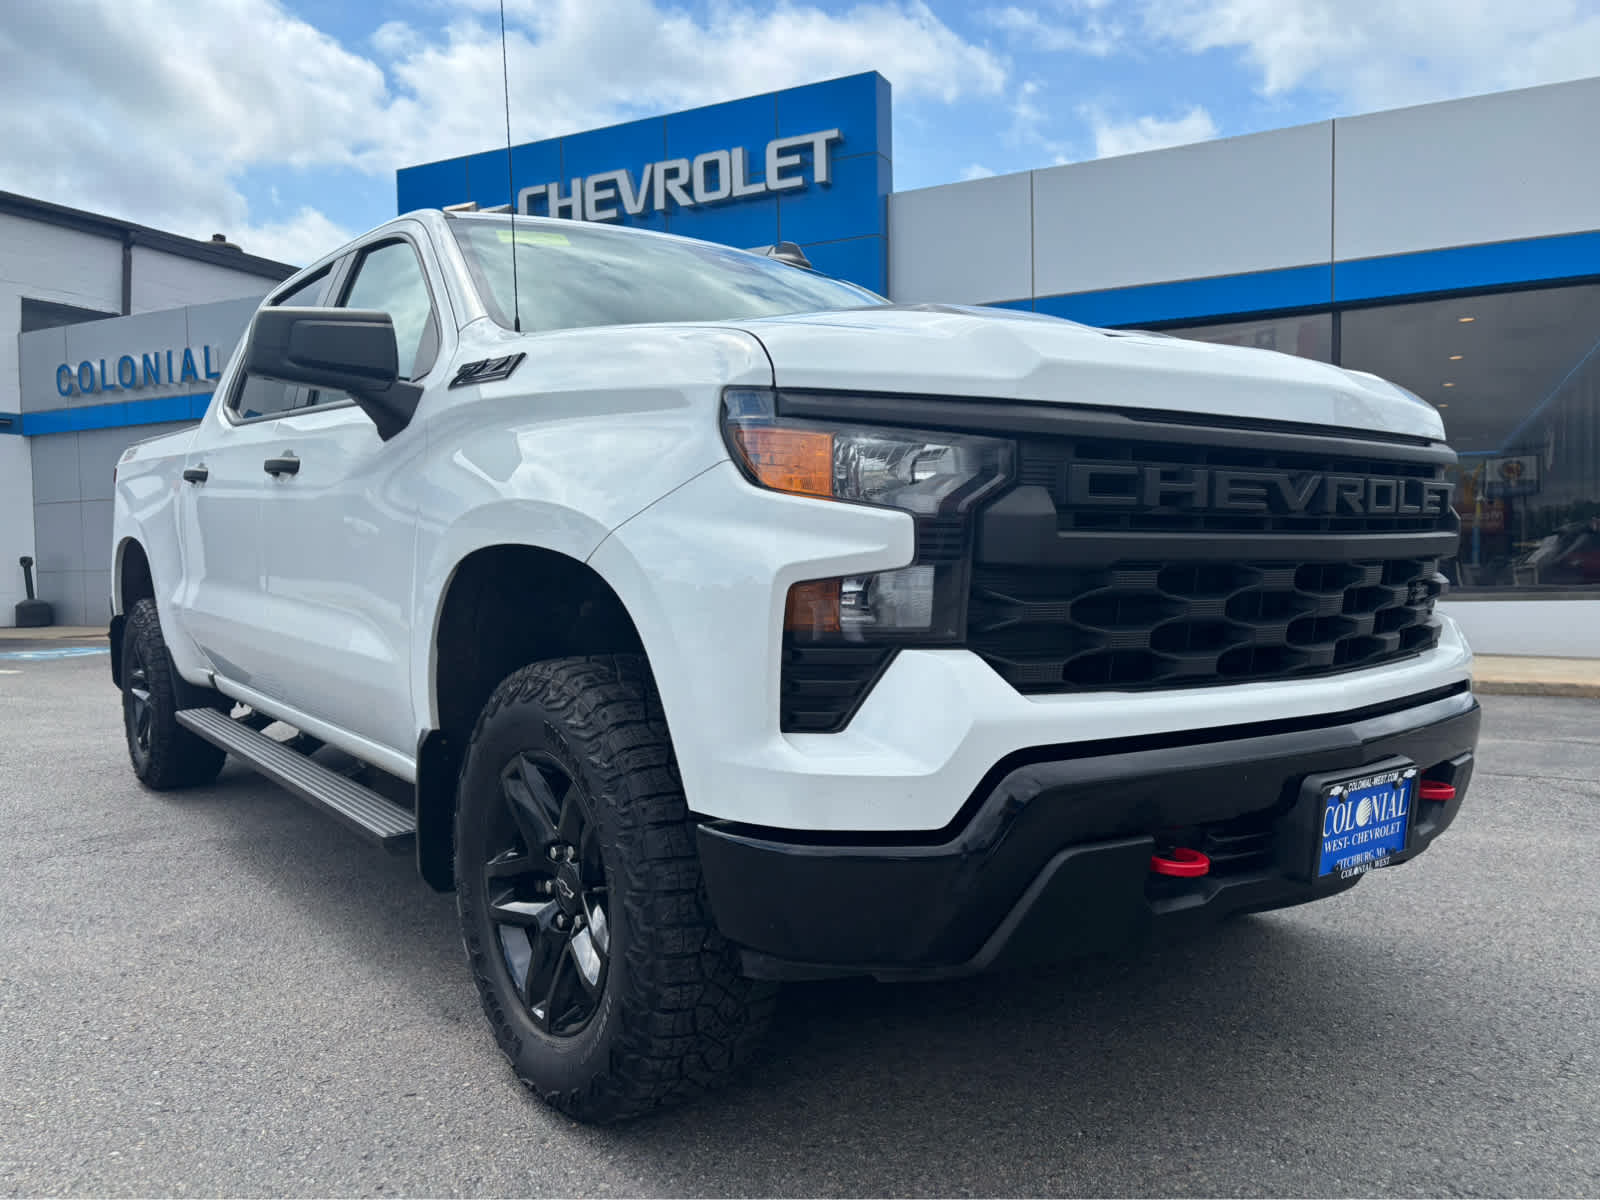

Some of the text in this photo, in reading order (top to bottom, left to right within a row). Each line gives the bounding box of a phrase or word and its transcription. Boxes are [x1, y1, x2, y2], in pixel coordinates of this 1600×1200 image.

[517, 128, 843, 222] CHEVROLET
[56, 345, 221, 397] COLONIAL
[1071, 463, 1456, 514] CHEVROLET
[1348, 771, 1399, 793] COLONIAL-WEST.COM
[1322, 788, 1407, 838] COLONIAL
[1351, 821, 1401, 846] CHEVROLET
[1374, 856, 1391, 868] WEST
